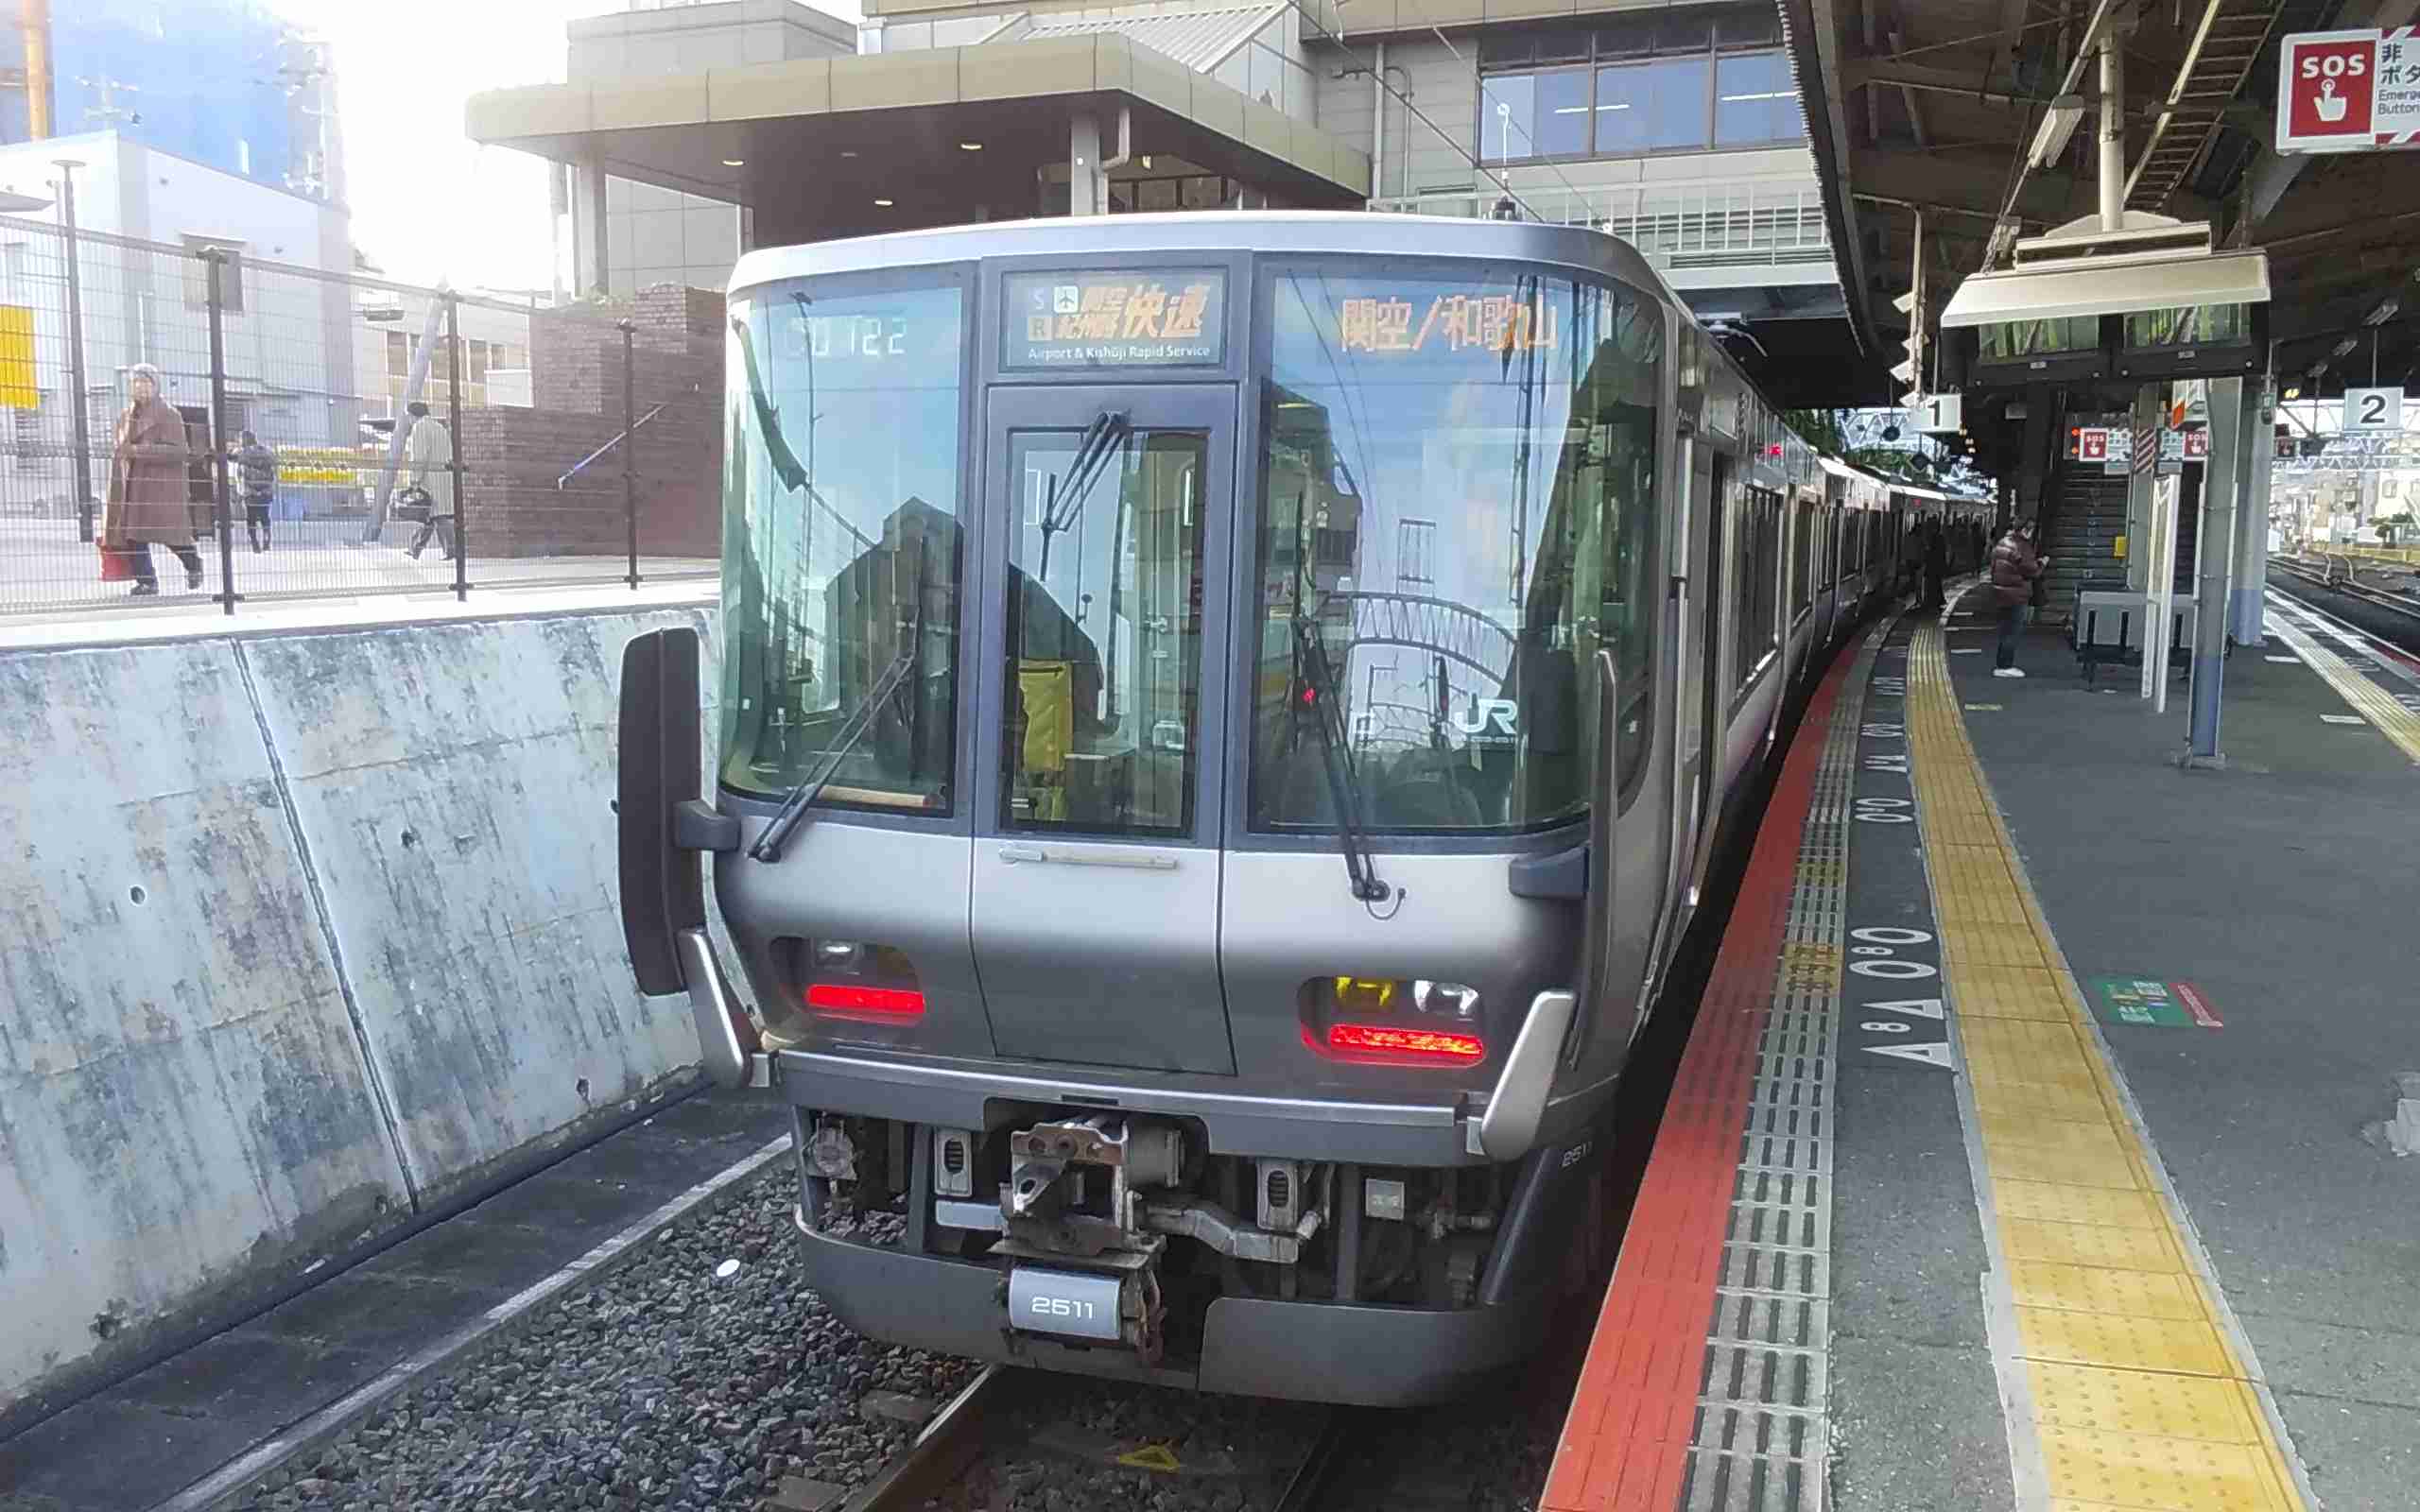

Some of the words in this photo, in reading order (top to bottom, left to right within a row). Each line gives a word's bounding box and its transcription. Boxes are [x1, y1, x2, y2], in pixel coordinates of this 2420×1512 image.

[2302, 53, 2366, 79] SOS
[2381, 43, 2403, 63] 非
[1123, 284, 1211, 339] 快速
[1028, 347, 1072, 360] Airport
[1129, 346, 1164, 360] Rapid
[1167, 344, 1211, 357] Service
[1927, 400, 1941, 427] 1
[2360, 394, 2387, 424] 2
[1453, 698, 1517, 734] JR
[1031, 1297, 1094, 1320] 2511
